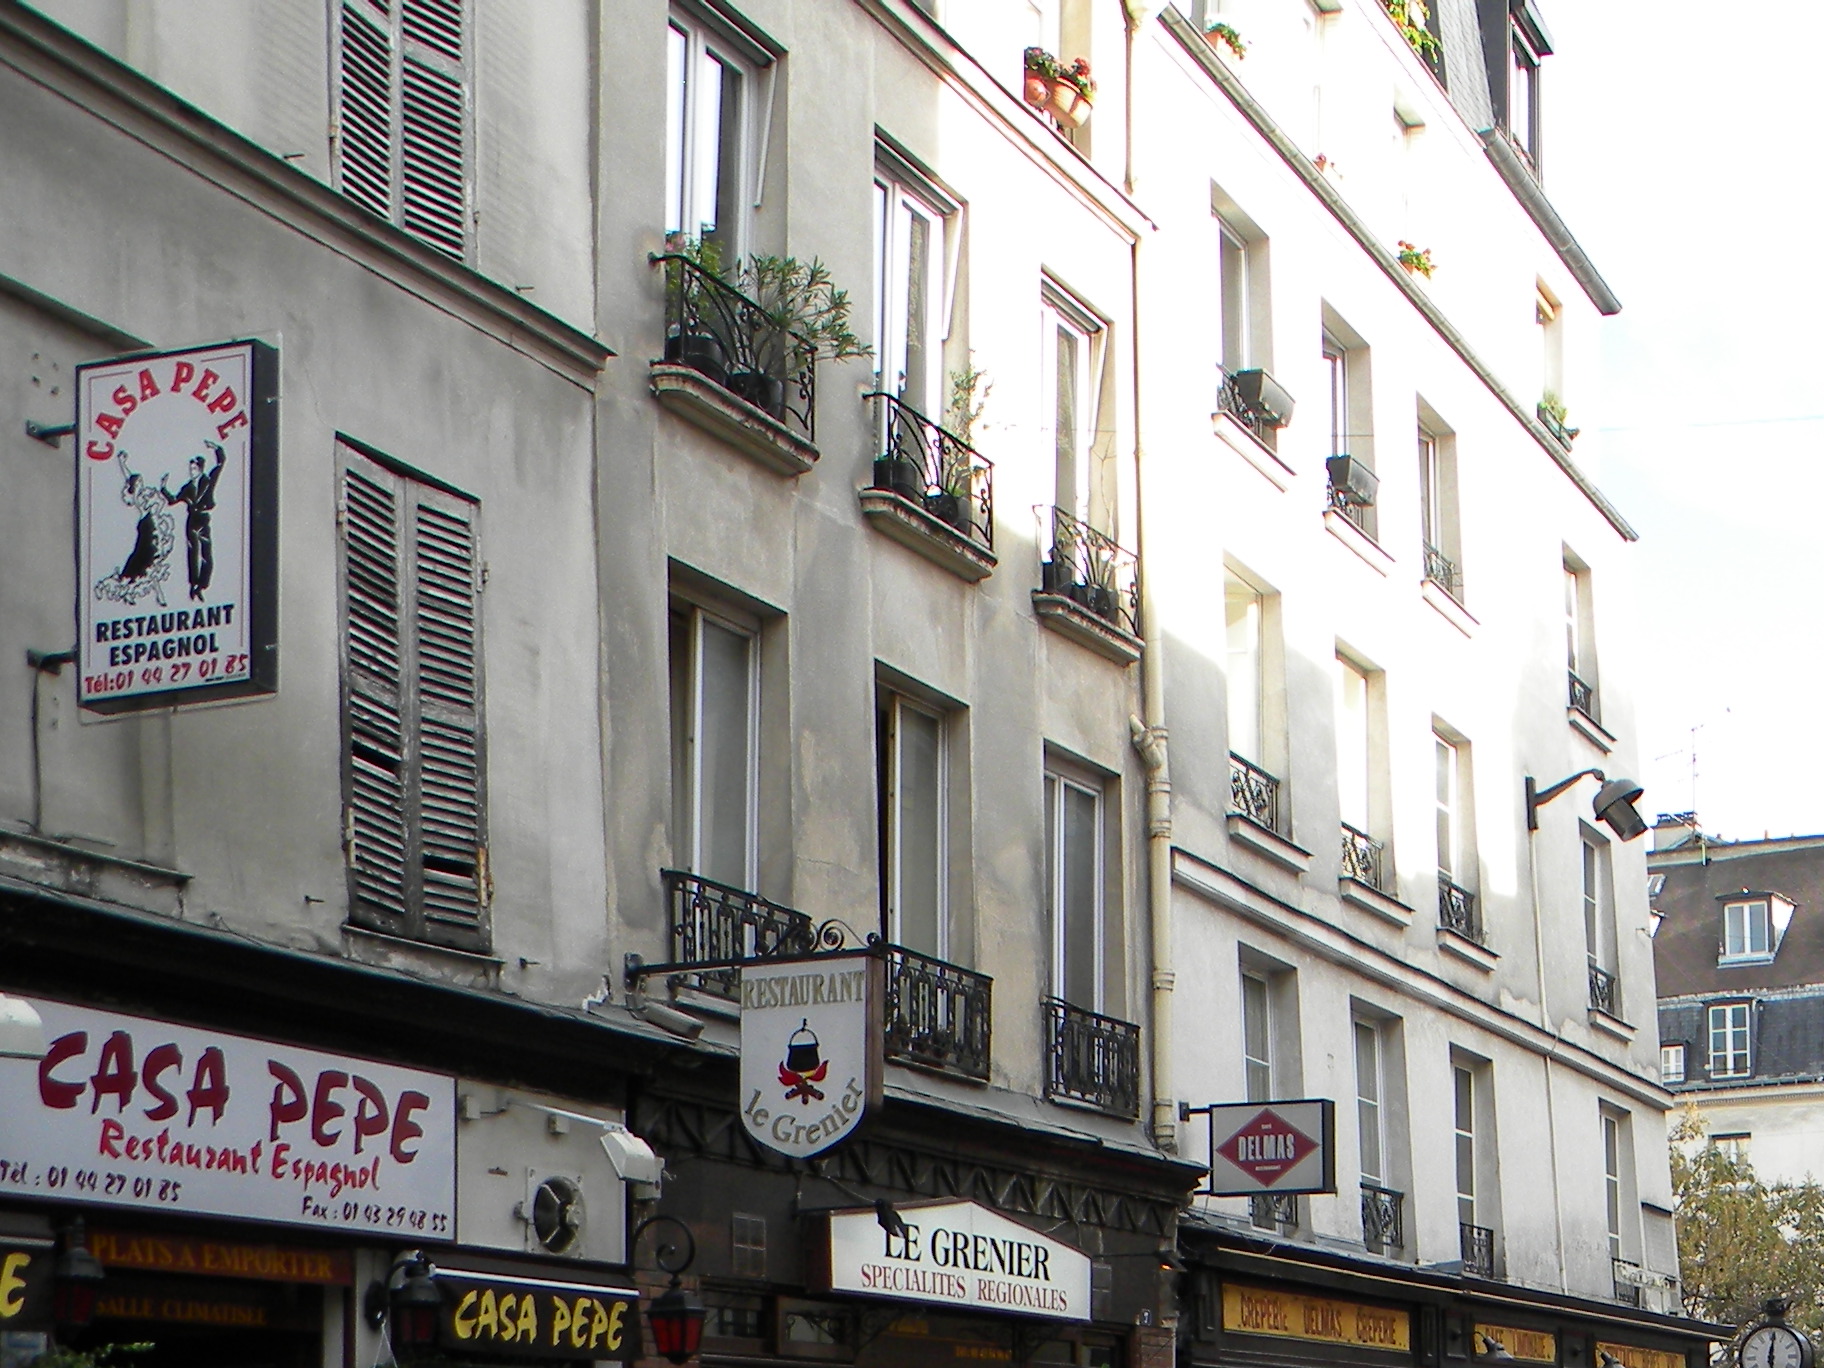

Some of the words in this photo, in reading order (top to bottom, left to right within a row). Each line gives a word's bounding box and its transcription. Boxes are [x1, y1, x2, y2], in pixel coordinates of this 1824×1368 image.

[86, 368, 161, 462] CASA
[170, 361, 249, 440] PEPE
[97, 604, 235, 642] RESTAURANT
[110, 633, 219, 667] ESPAGNOL
[170, 662, 192, 682] 27
[198, 658, 218, 678] 01
[741, 970, 866, 1010] RESTAURANT
[38, 1030, 230, 1128] CASA
[267, 1059, 431, 1165] PEPE
[744, 1089, 770, 1127] le
[771, 1077, 864, 1145] Grenier
[99, 1118, 263, 1176] Restaurant
[271, 1143, 381, 1198] Espagnol
[1238, 1133, 1295, 1162] DELMAS
[48, 1166, 68, 1188] 01
[104, 1172, 127, 1196] 27
[133, 1177, 152, 1198] 01
[302, 1196, 329, 1220] Fax
[343, 1201, 359, 1221] 01
[364, 1203, 381, 1224] 43
[387, 1206, 405, 1227] 29
[432, 1213, 449, 1232] 55
[91, 1233, 174, 1266] PLATS
[179, 1244, 197, 1268] A
[203, 1243, 334, 1279] EMPORTER
[884, 1222, 922, 1262] LE
[931, 1227, 1051, 1281] GRENIER
[860, 1263, 967, 1299] SPECIALITES
[977, 1278, 1068, 1312] REGIONALES
[455, 1288, 538, 1345] CASA
[553, 1295, 629, 1351] PEPE
